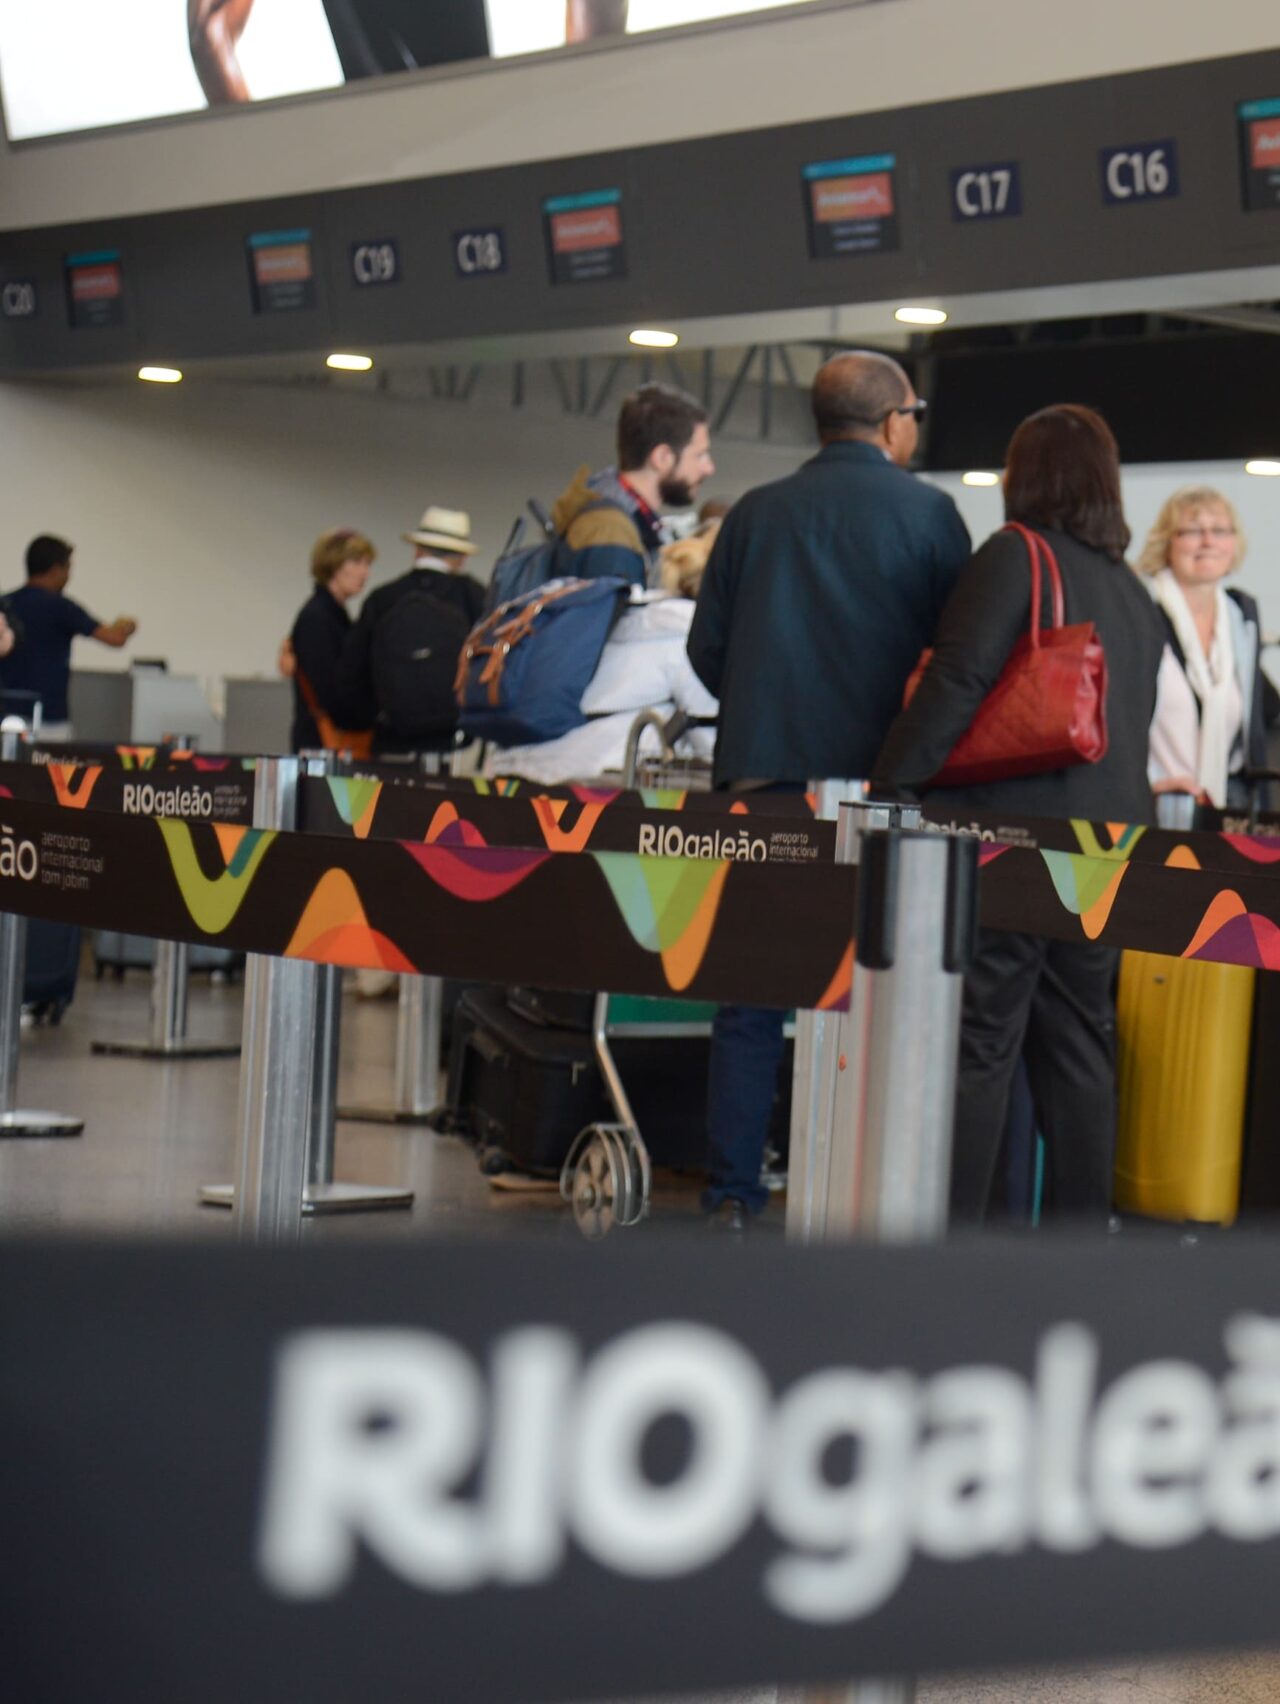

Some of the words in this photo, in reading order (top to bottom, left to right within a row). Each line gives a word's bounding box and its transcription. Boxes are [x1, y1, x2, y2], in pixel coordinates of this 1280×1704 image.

[1106, 149, 1170, 199] C16
[955, 169, 1011, 216] C17
[353, 243, 396, 283] C19
[457, 232, 501, 273] C18
[122, 784, 213, 819] RIOgaleão
[41, 832, 90, 852] aeroporto
[768, 842, 819, 859] internacional
[770, 832, 809, 846] aeroporto
[41, 851, 104, 874] internacional
[41, 869, 60, 885] tom
[61, 871, 89, 890] jobim
